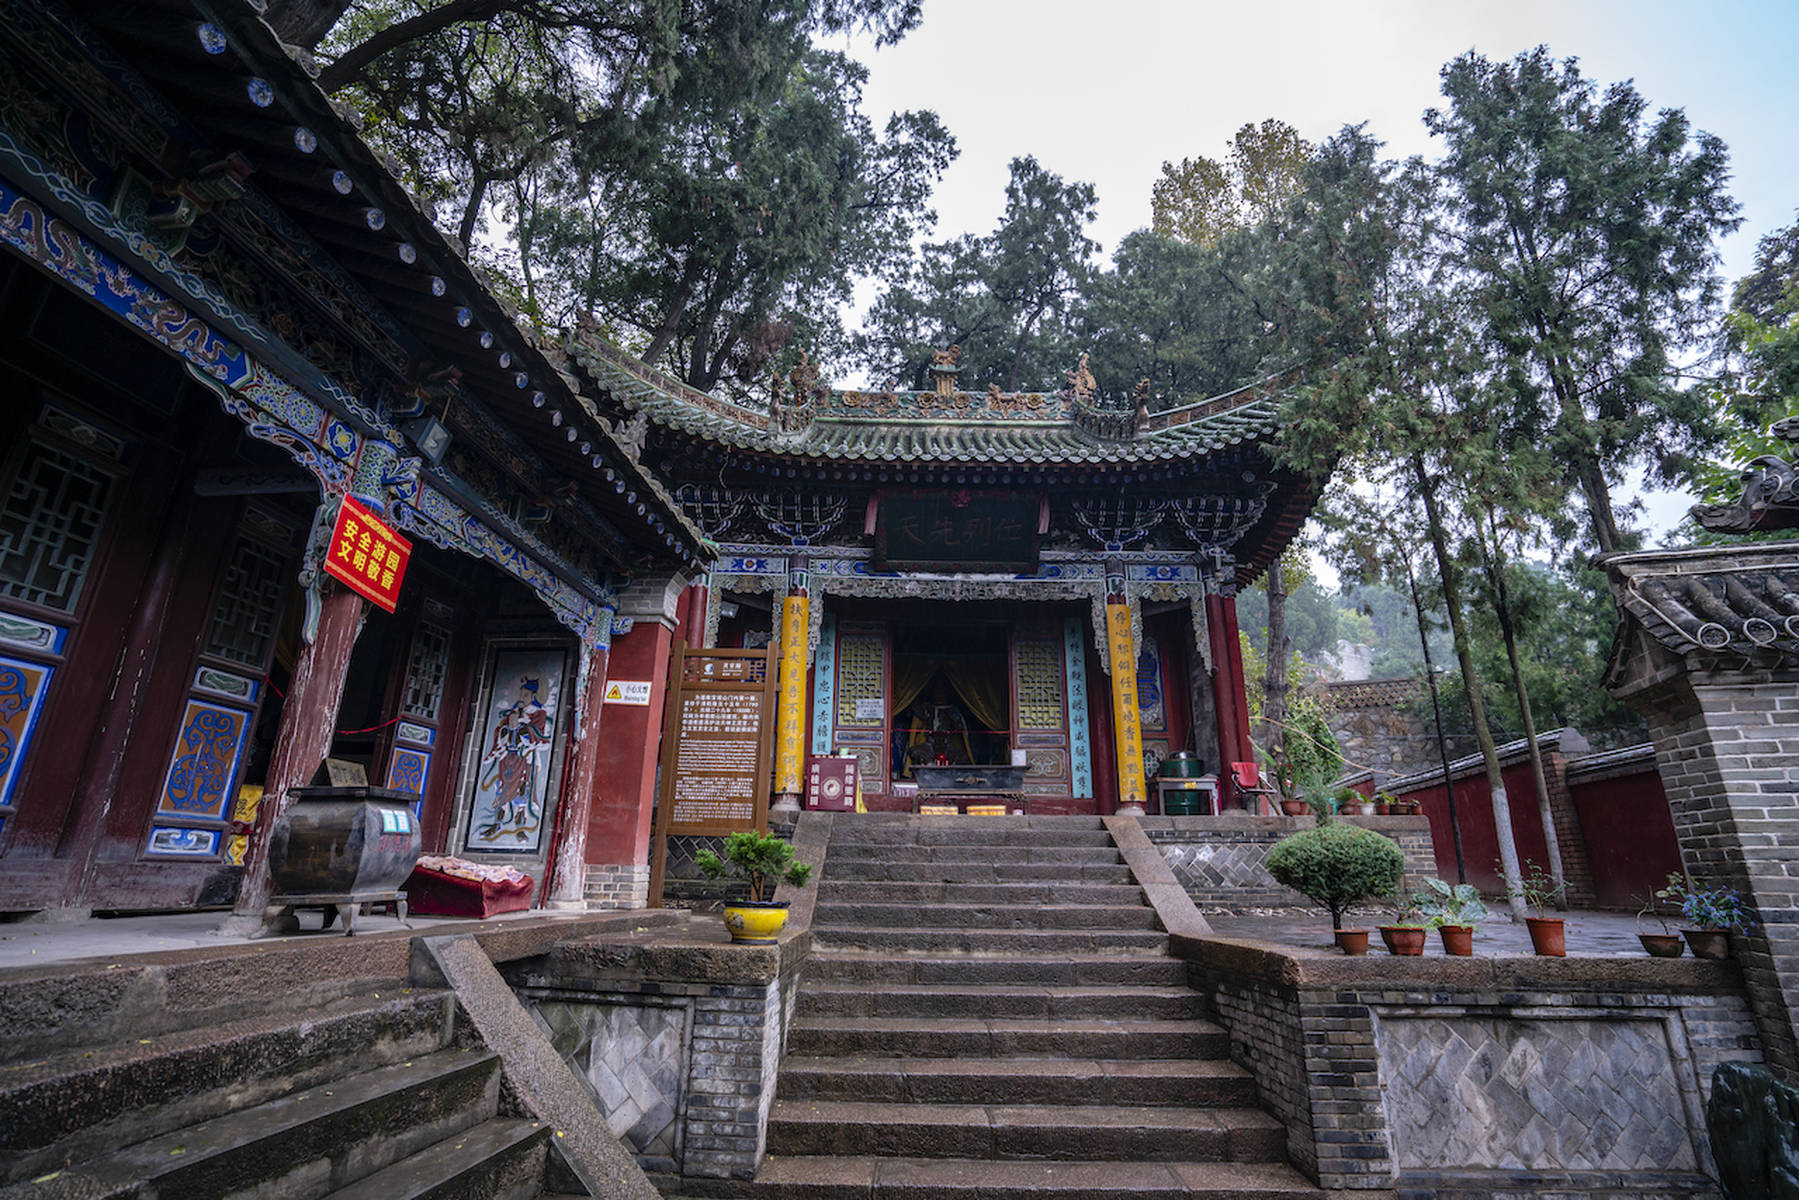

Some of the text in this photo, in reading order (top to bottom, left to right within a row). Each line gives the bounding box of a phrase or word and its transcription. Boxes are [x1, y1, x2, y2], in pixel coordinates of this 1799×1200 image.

[337, 540, 396, 591] 文明敬香
[342, 519, 401, 573] 安全游园
